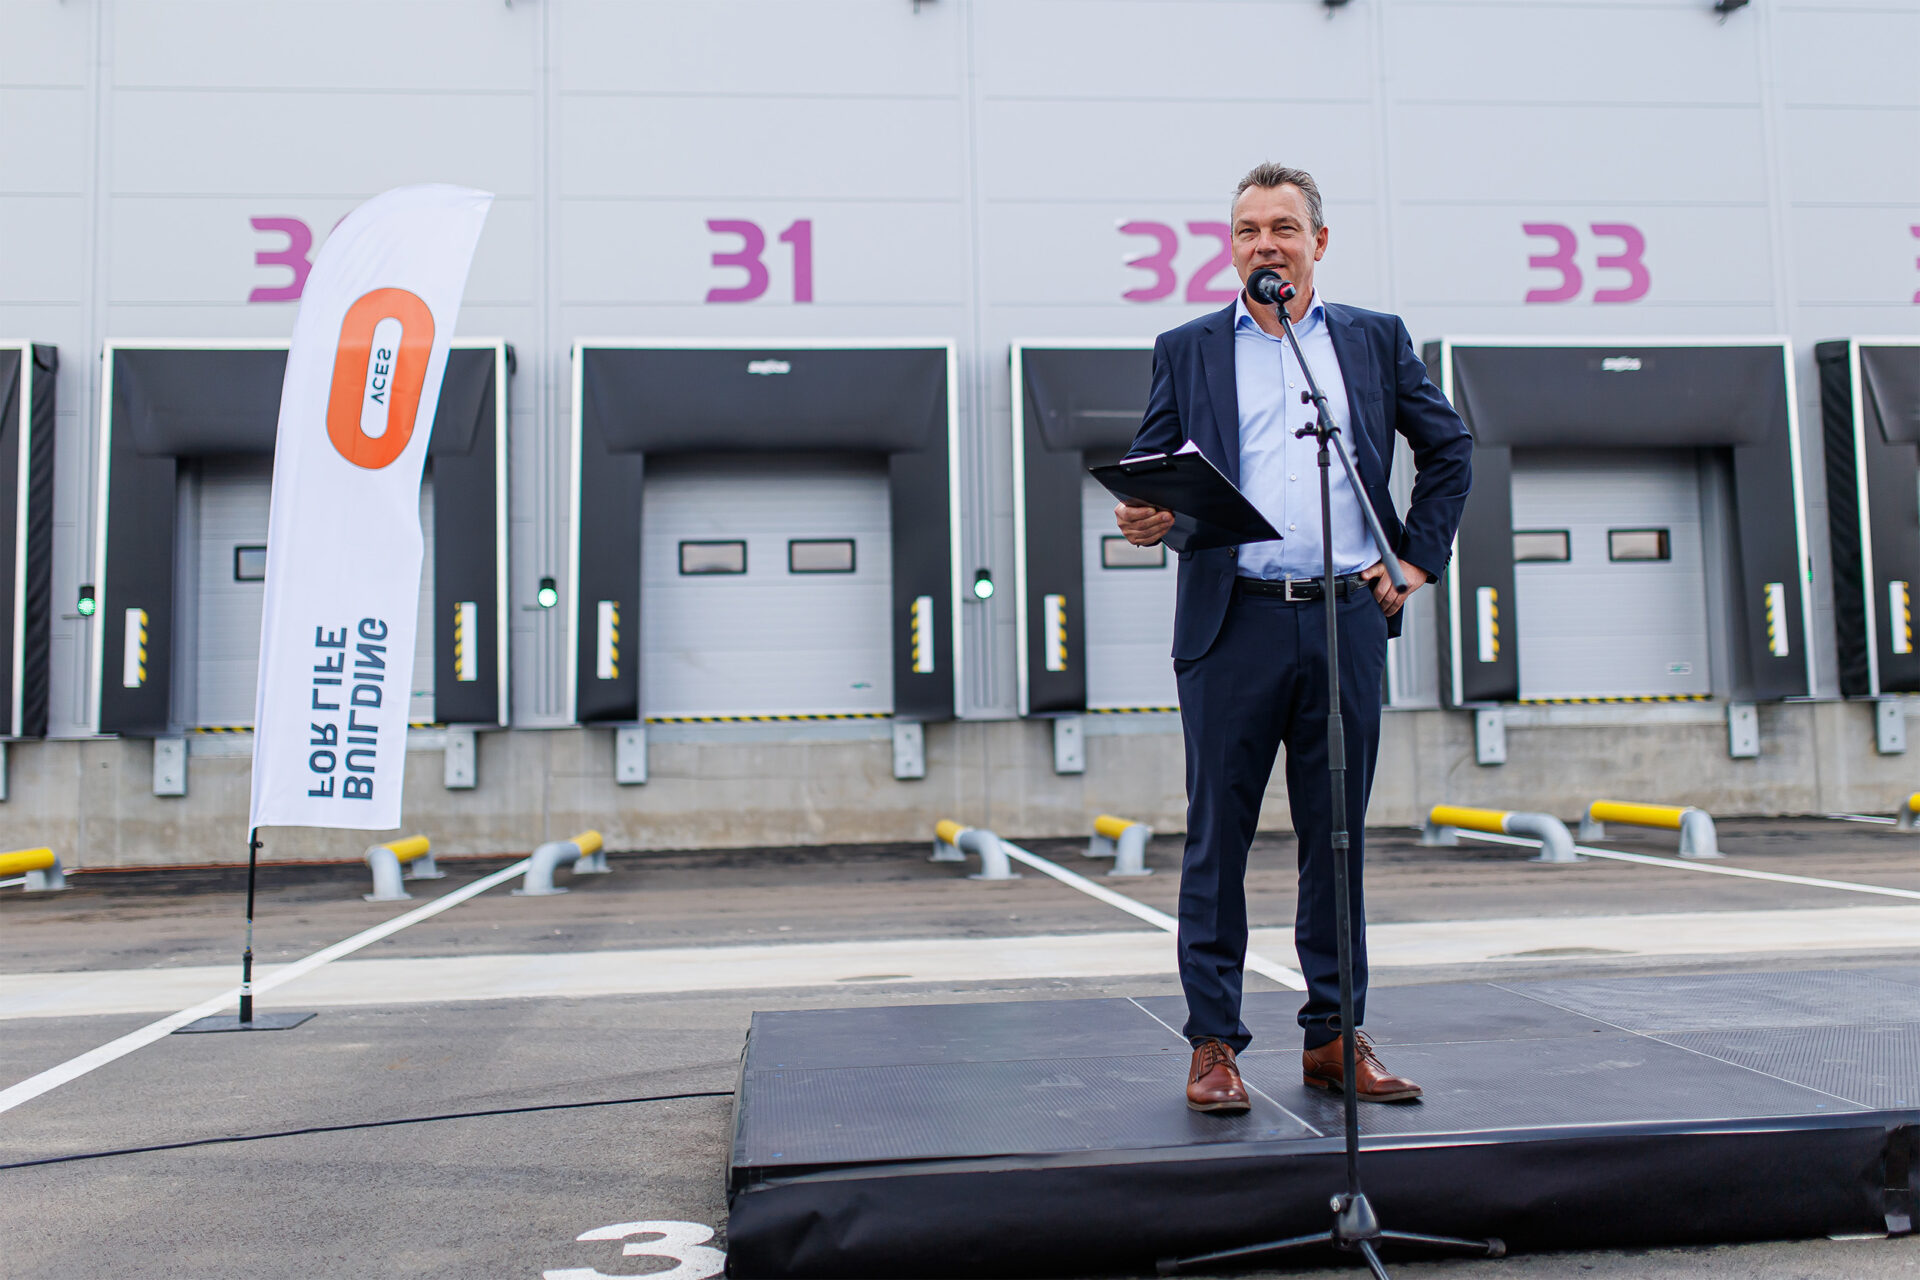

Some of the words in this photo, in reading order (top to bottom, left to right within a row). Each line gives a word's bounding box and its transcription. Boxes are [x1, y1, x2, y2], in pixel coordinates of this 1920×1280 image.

[706, 218, 814, 303] 31
[1119, 221, 1239, 303] 32
[1522, 223, 1652, 304] 33
